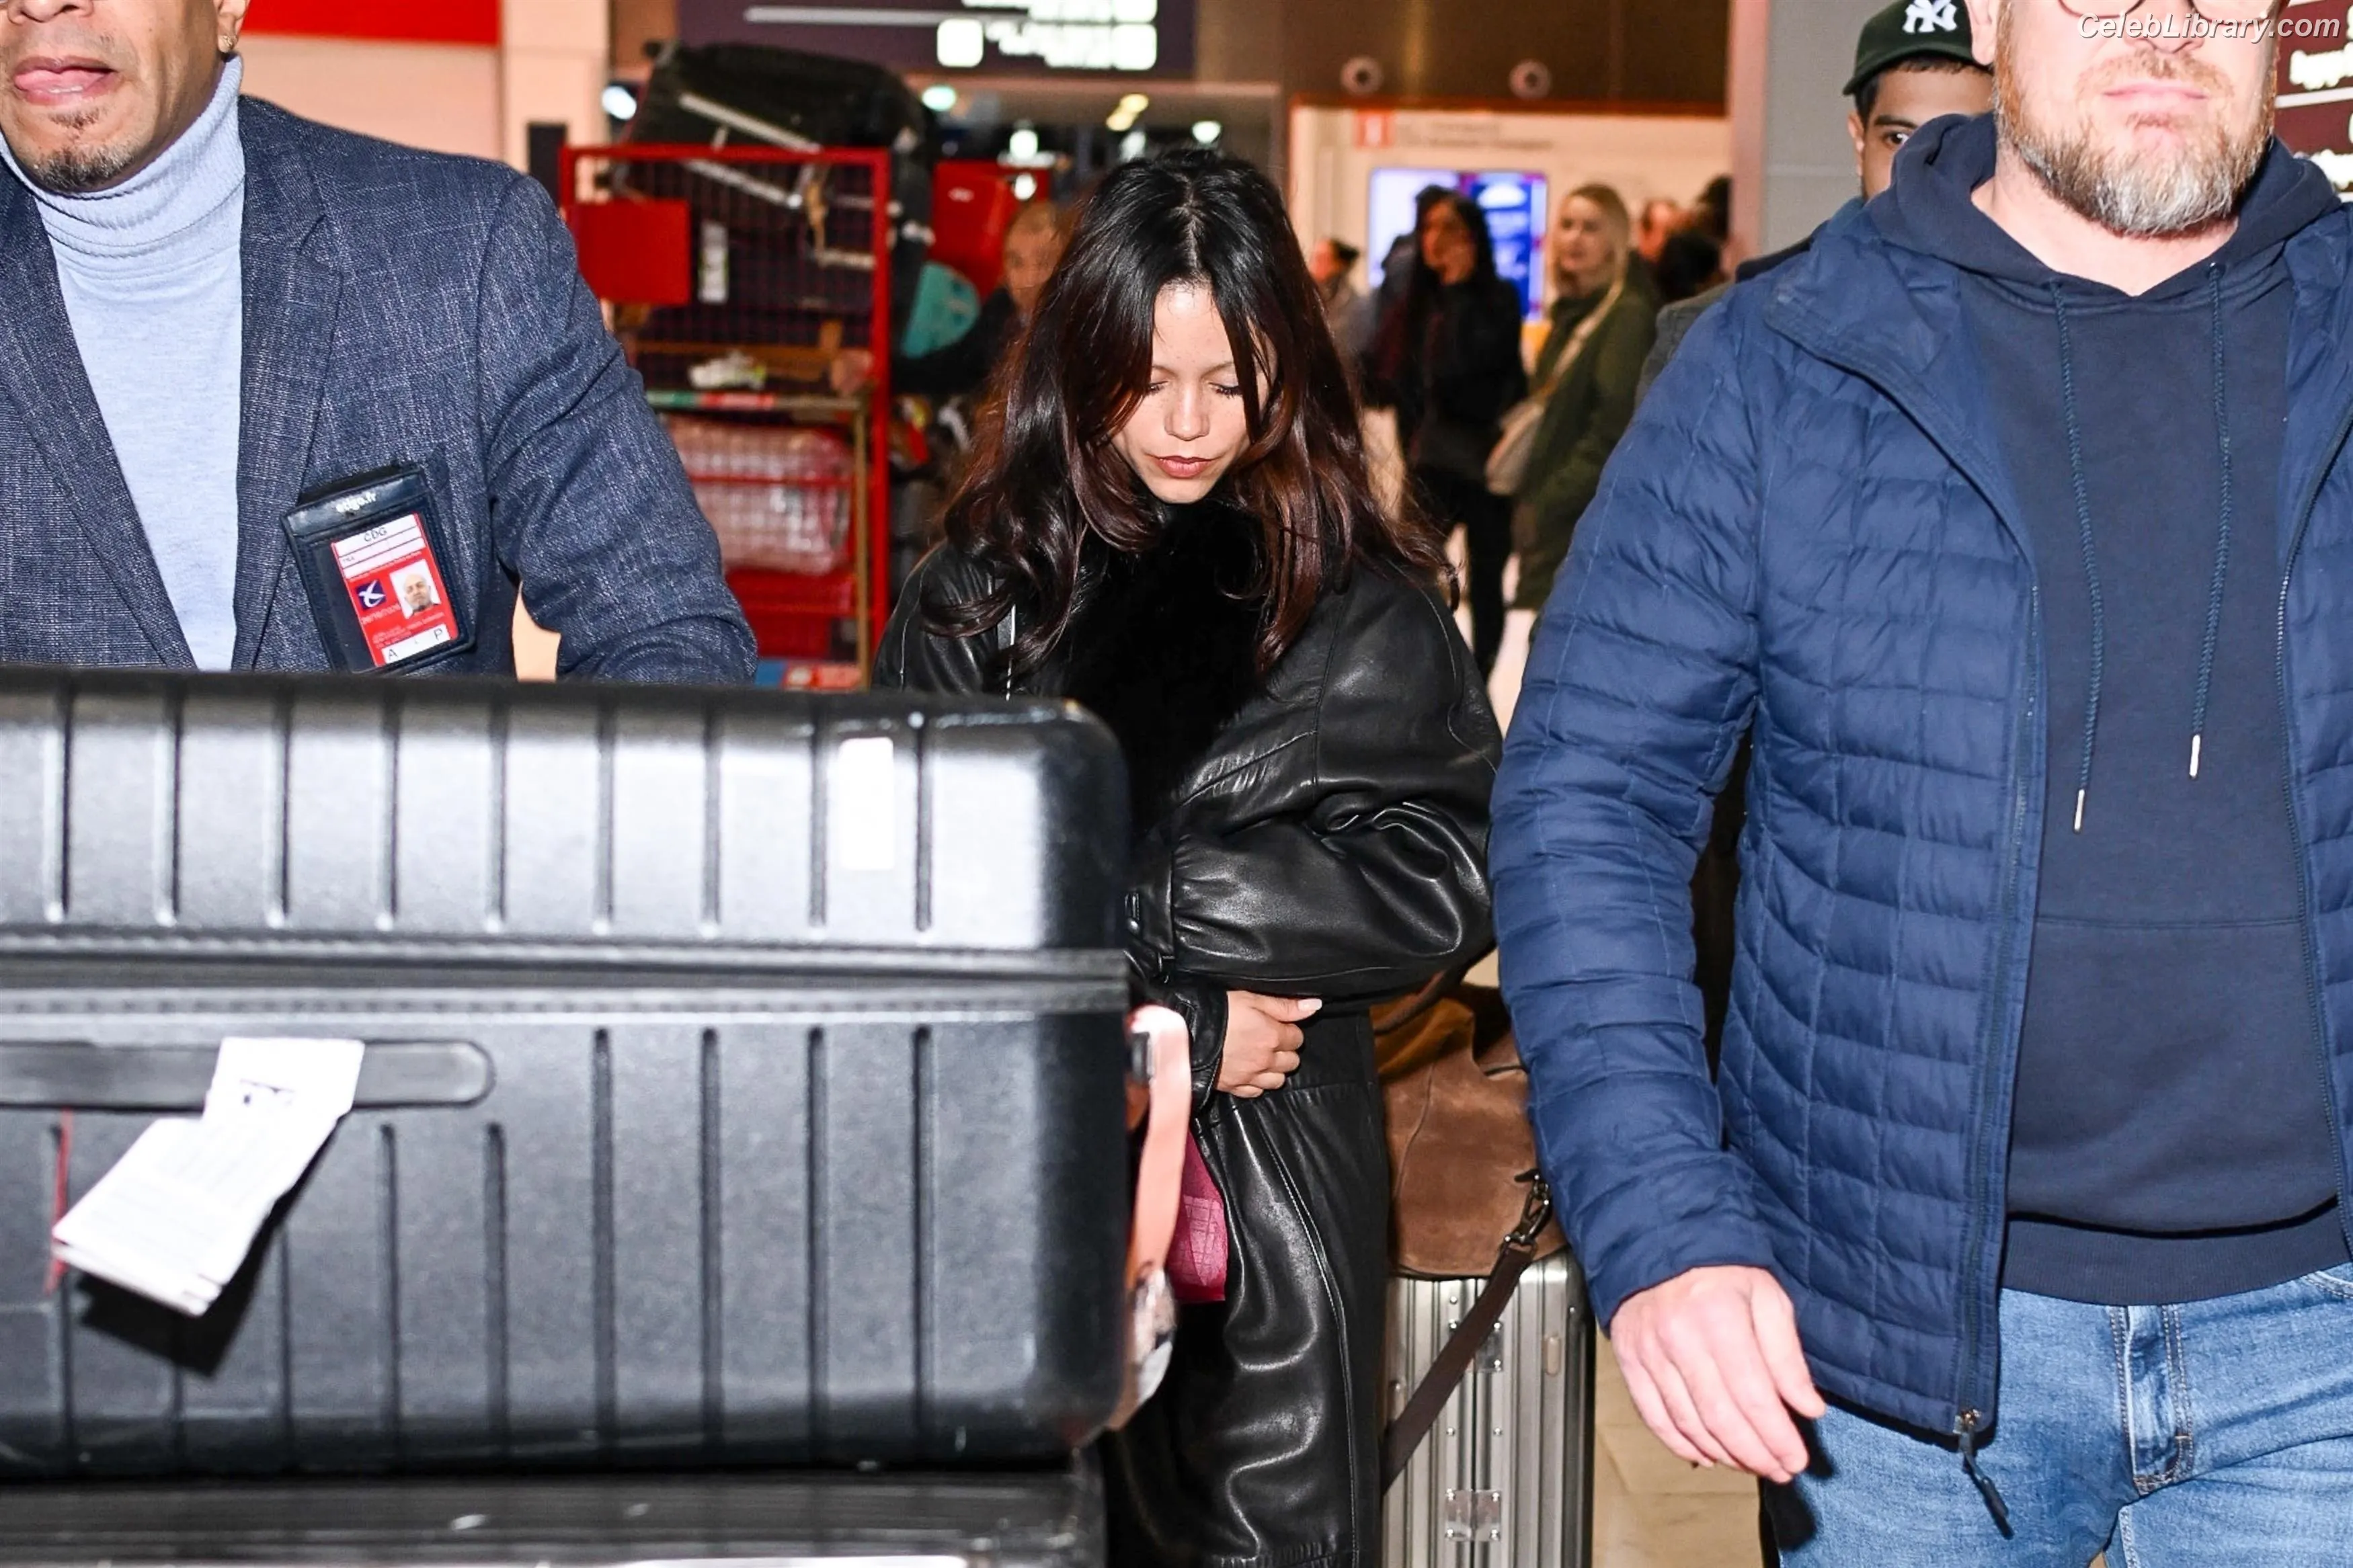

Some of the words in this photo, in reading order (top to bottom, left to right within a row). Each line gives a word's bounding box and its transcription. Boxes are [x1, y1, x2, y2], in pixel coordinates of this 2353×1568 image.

[364, 527, 388, 542] CDG
[388, 649, 398, 659] A
[434, 628, 443, 641] P
